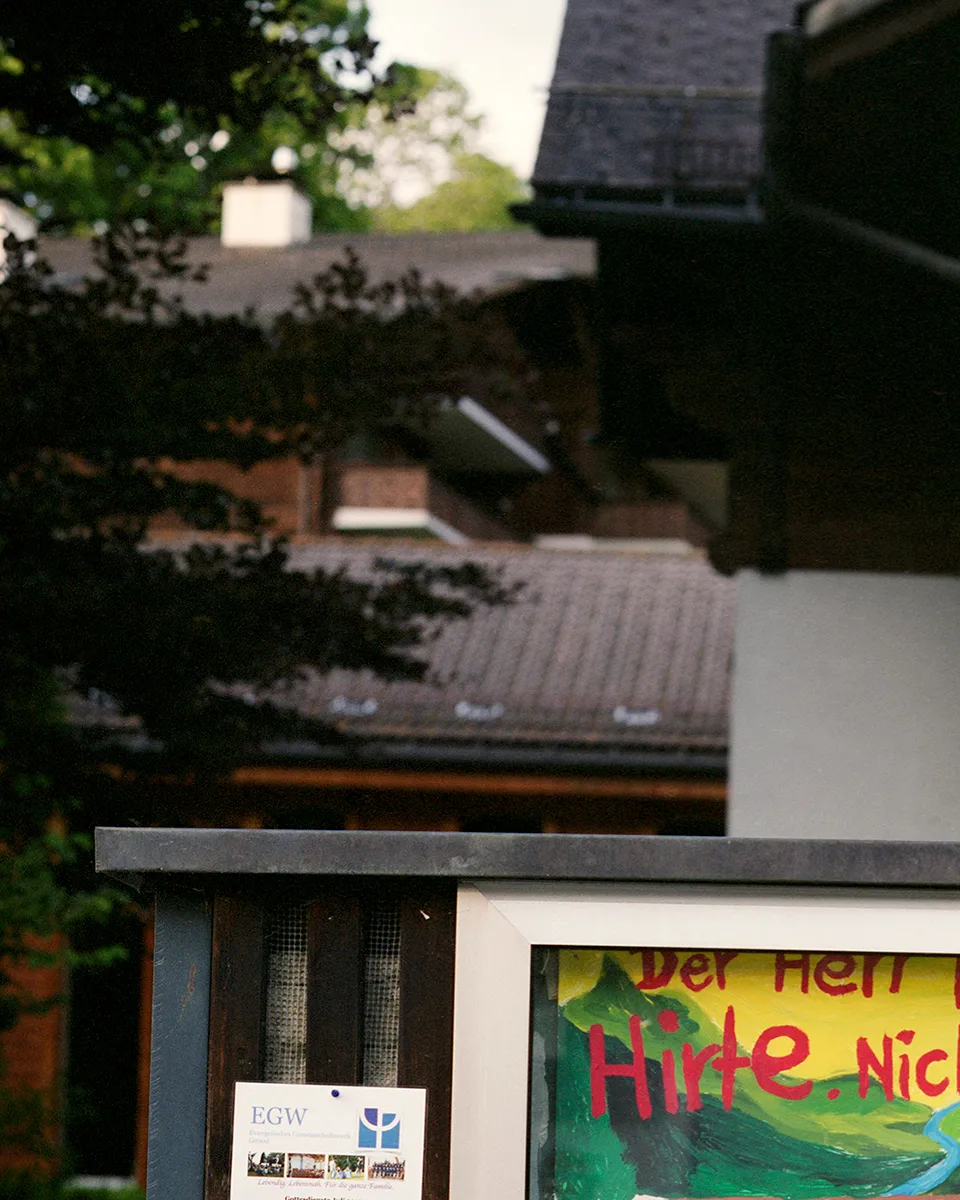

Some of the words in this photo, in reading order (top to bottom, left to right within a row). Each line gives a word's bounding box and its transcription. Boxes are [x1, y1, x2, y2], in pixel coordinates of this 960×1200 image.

[630, 951, 738, 992] Der
[774, 953, 910, 998] Herr
[250, 1106, 308, 1126] EGW
